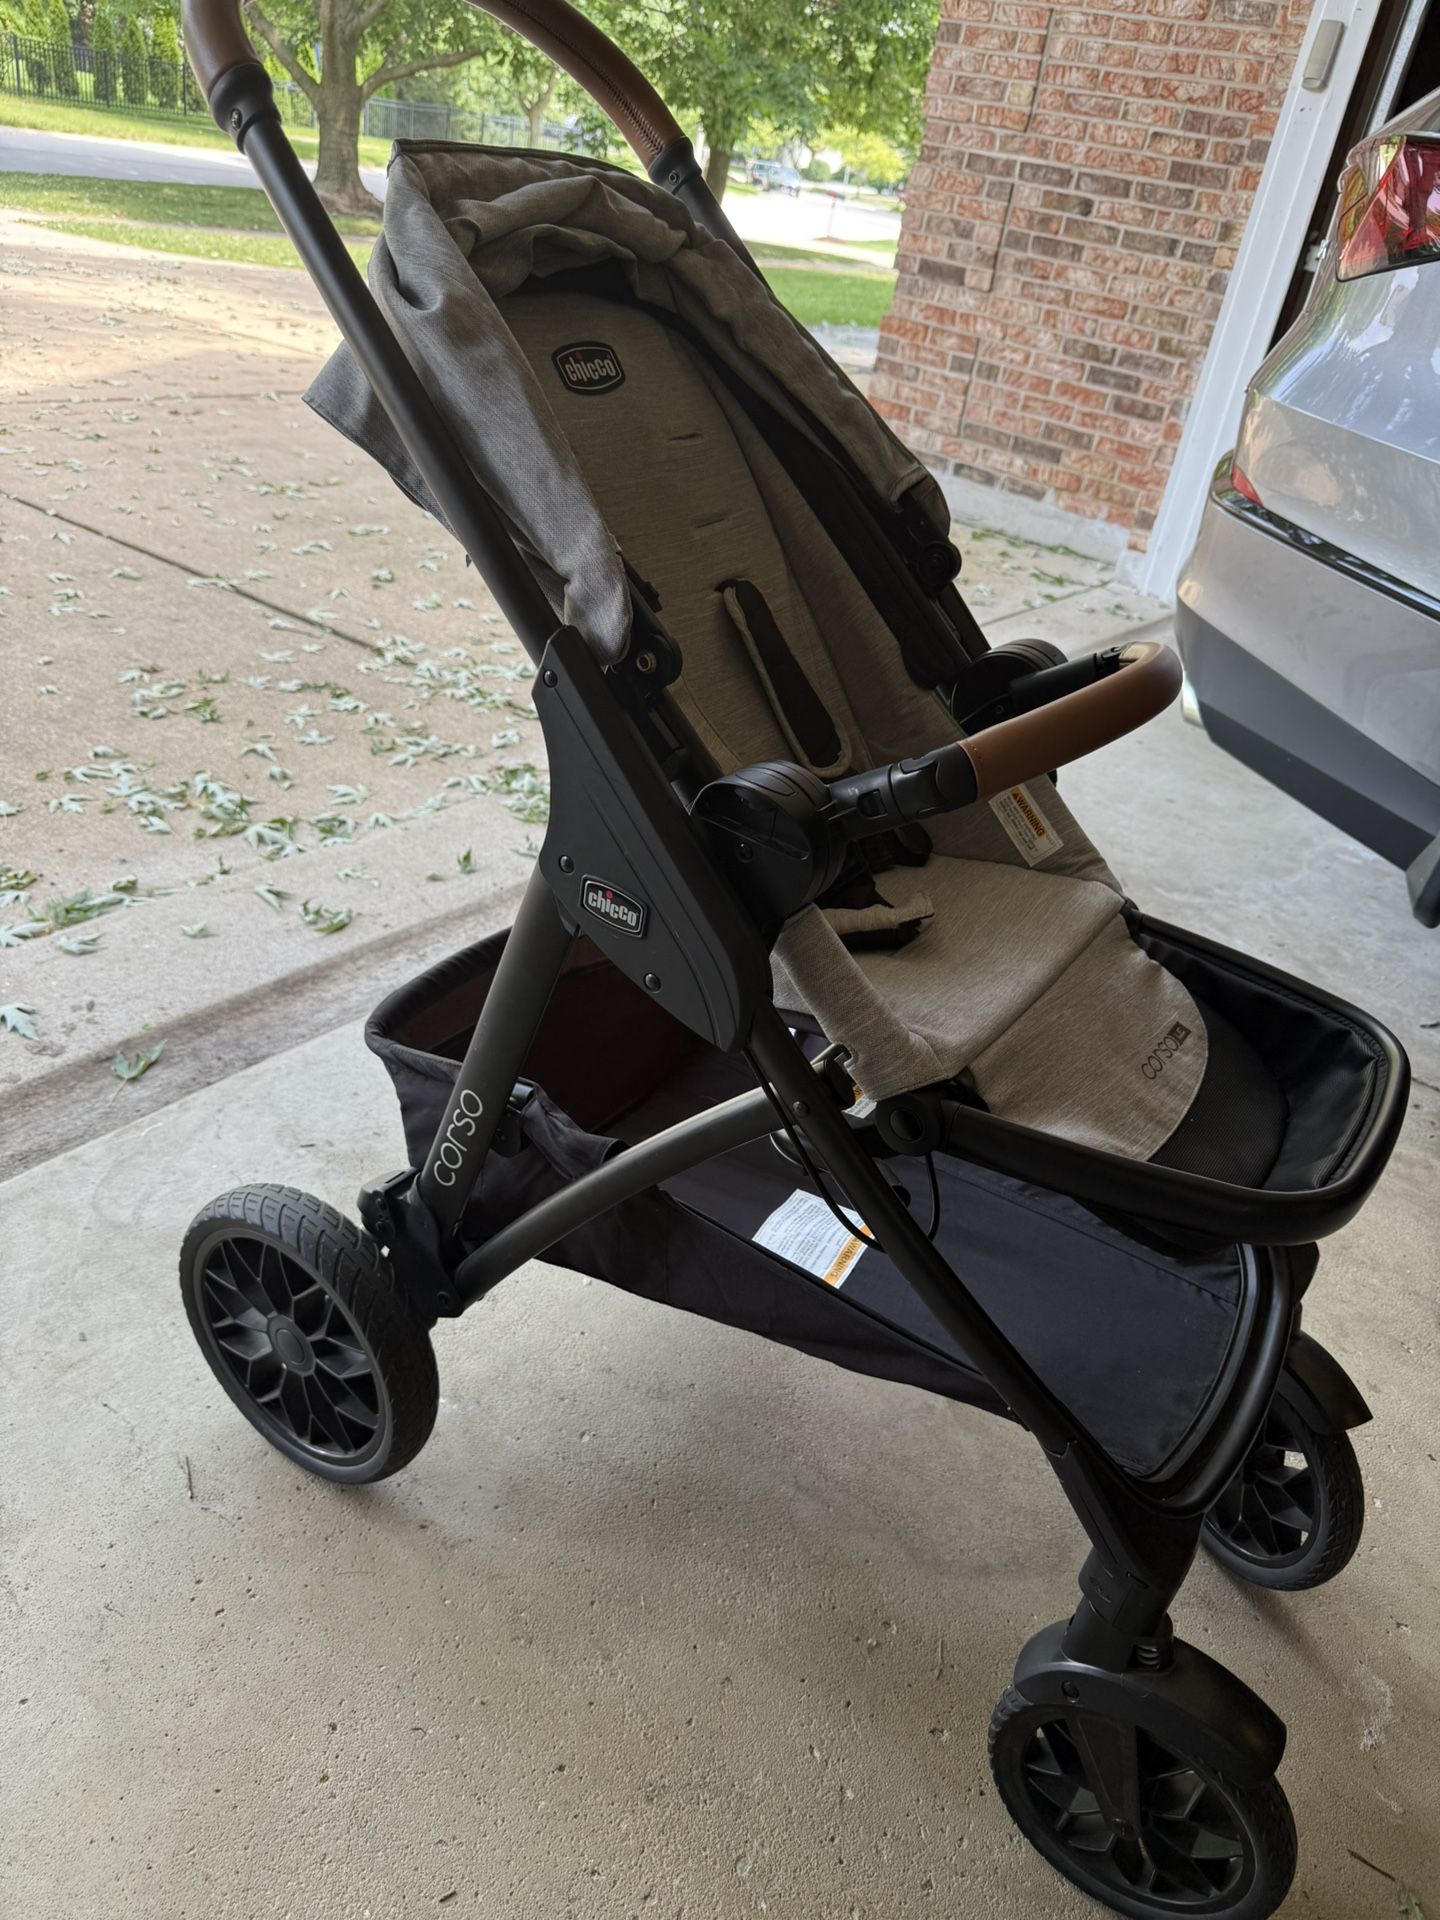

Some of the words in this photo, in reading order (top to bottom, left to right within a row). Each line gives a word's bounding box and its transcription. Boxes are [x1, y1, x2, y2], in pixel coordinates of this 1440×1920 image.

[1016, 795, 1045, 837] WARNING
[588, 889, 637, 927] chicco
[1141, 1036, 1179, 1080] corso
[434, 1089, 483, 1186] corso
[829, 1242, 858, 1278] WARNING
